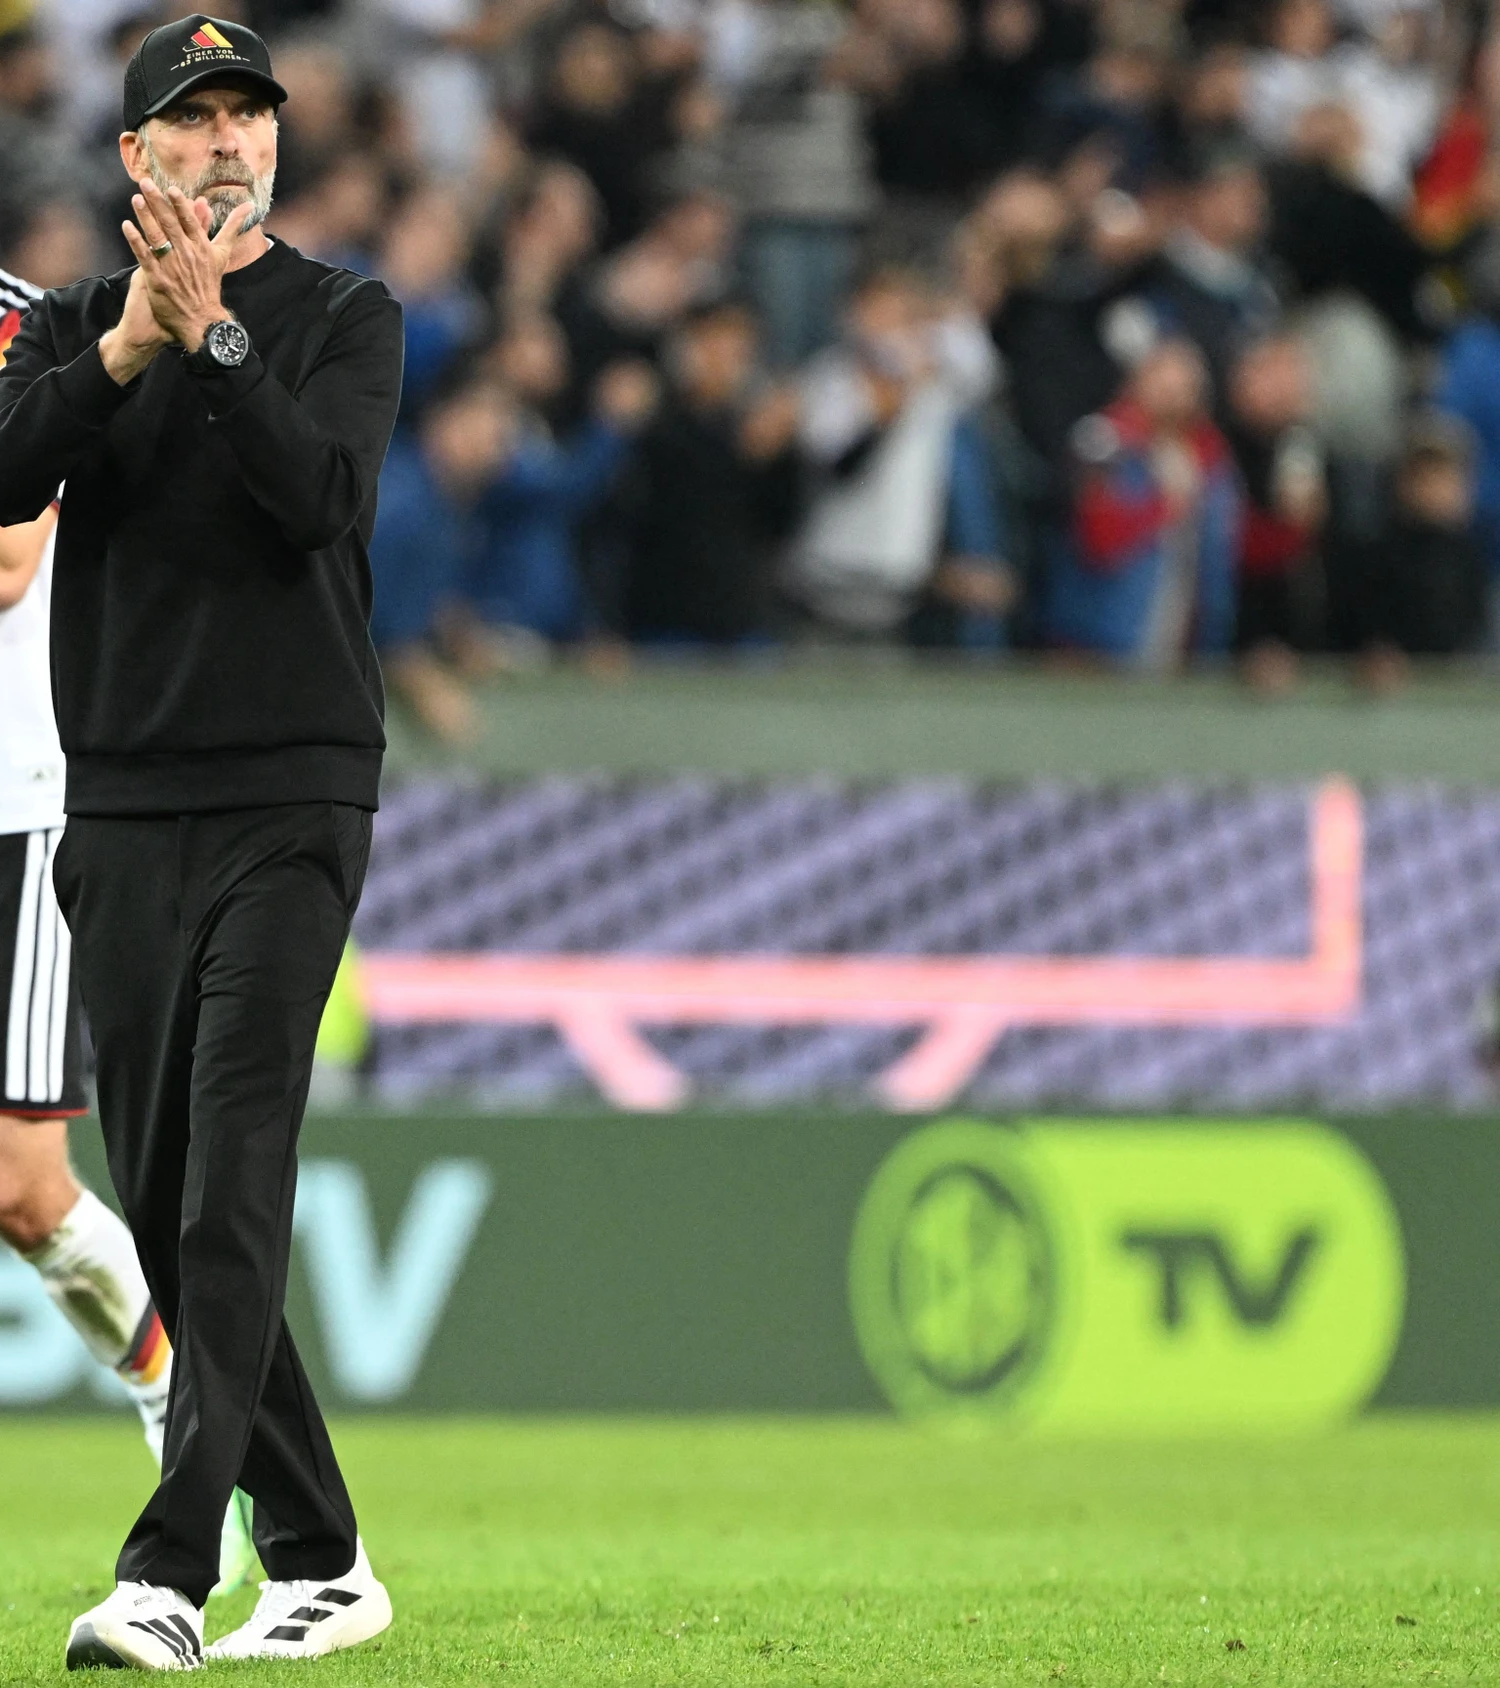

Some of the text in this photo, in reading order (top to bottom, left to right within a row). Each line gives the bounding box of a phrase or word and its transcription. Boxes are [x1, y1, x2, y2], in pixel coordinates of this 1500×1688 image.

[186, 50, 212, 60] EINER
[194, 54, 241, 62] MILLIONEN
[1118, 1228, 1322, 1331] TV
